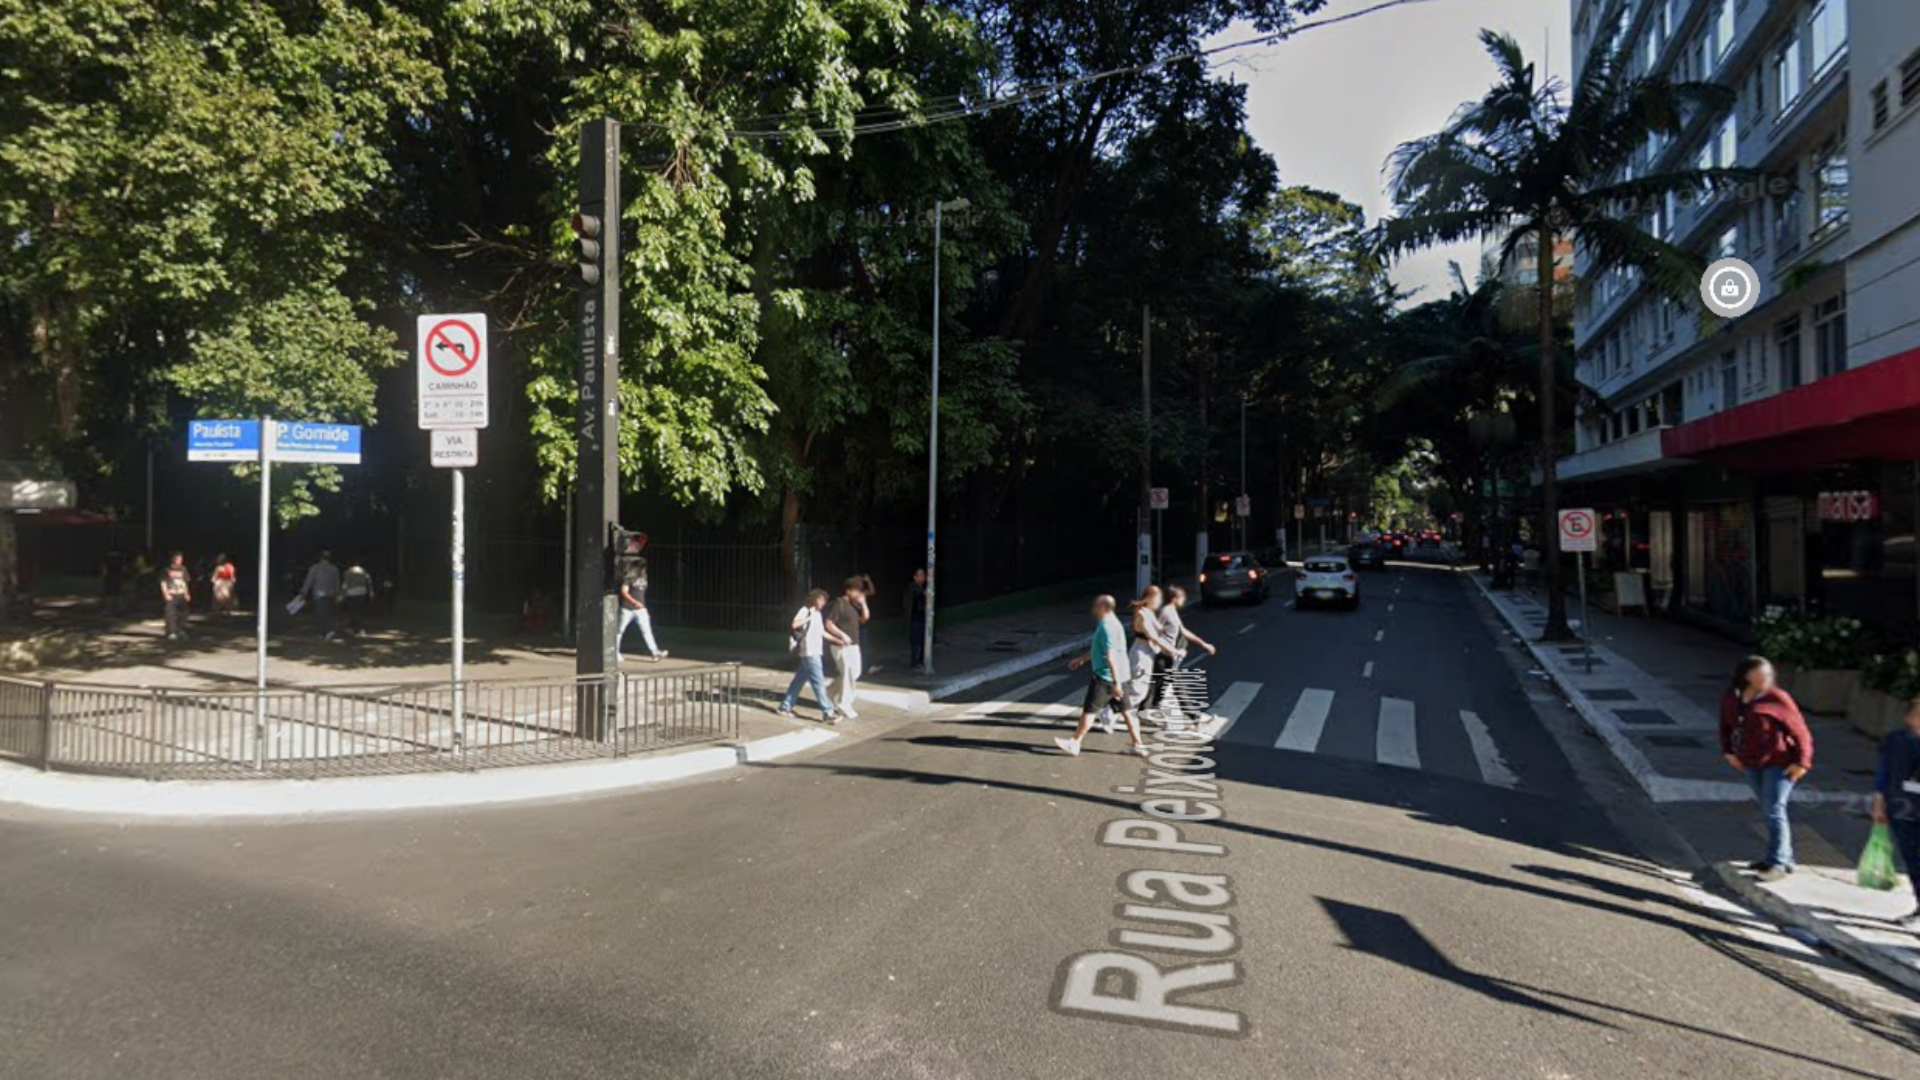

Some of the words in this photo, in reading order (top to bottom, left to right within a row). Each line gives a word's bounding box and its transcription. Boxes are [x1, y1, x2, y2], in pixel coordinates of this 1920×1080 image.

[581, 299, 596, 400] Paulista
[193, 422, 242, 438] Paulista
[581, 407, 596, 440] Av.
[278, 423, 288, 440] P.
[292, 423, 349, 442] Gomide
[445, 436, 463, 446] VIA
[434, 450, 473, 459] RESTRITA
